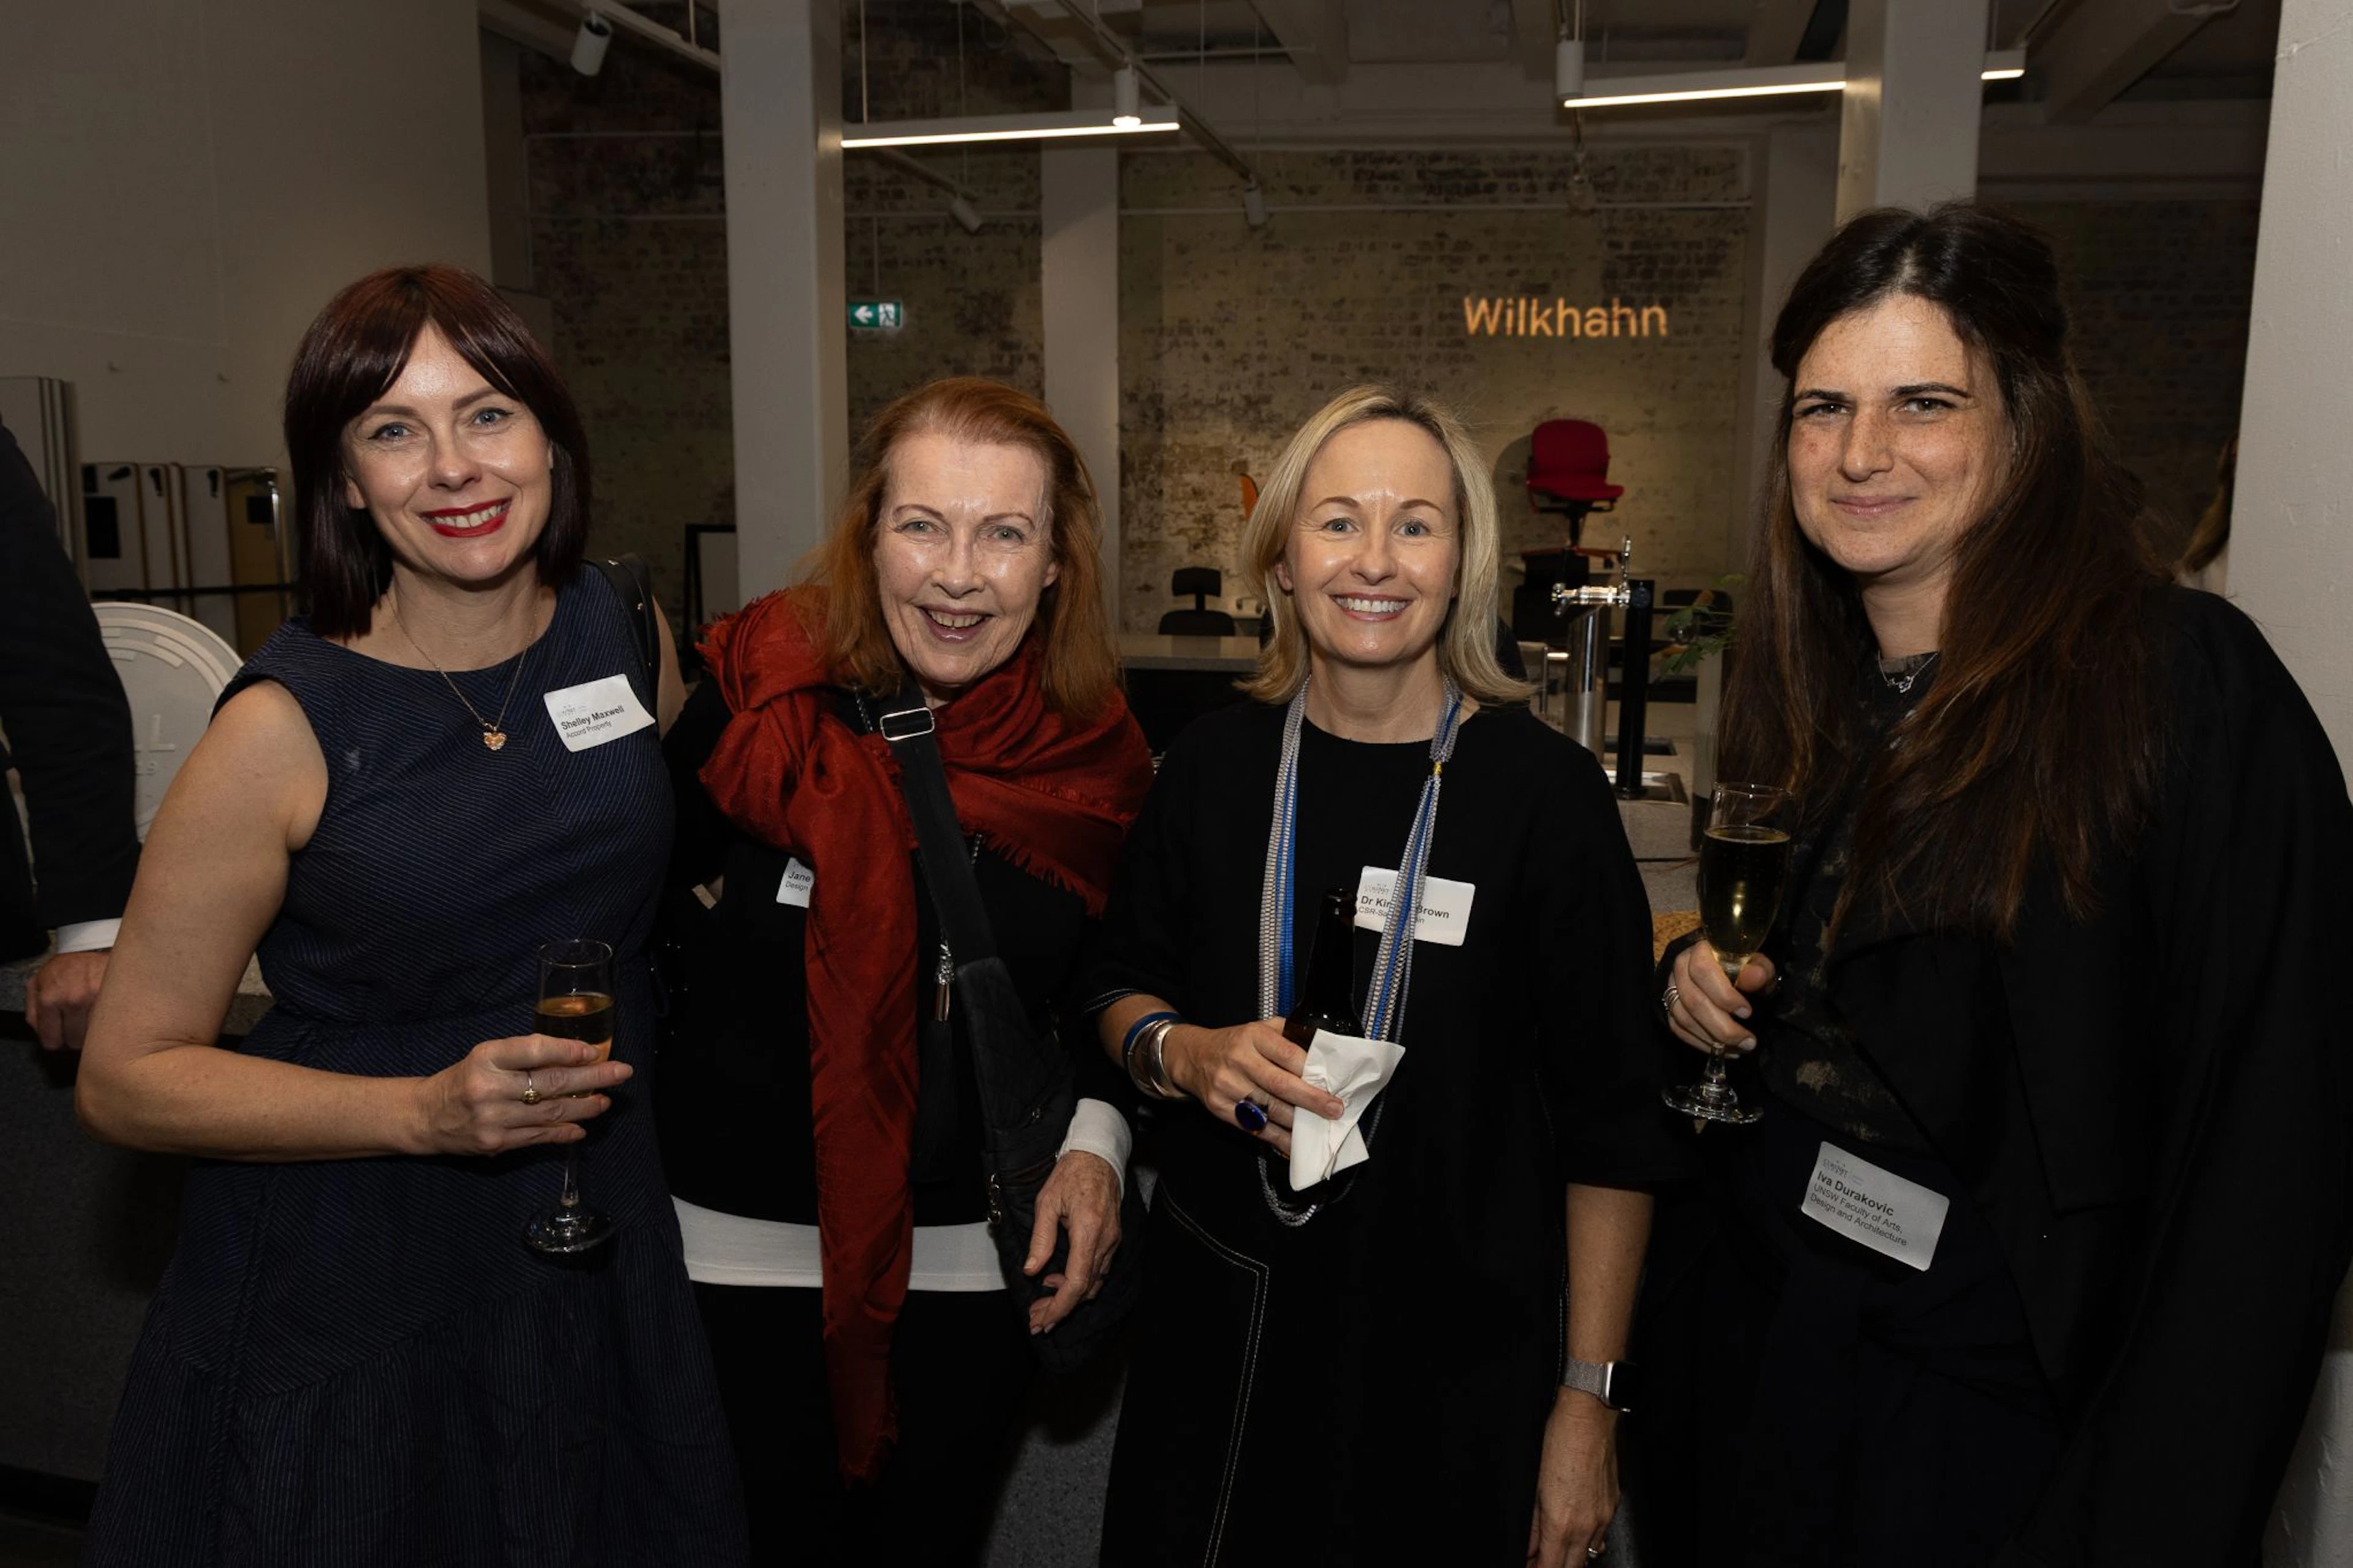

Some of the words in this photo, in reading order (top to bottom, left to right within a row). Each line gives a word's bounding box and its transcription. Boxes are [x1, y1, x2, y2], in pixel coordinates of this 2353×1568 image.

[1463, 297, 1668, 337] Wilkhahn
[560, 716, 591, 730] Shelley
[591, 705, 624, 721] Maxwell
[586, 721, 612, 732] Property
[786, 881, 808, 891] Design
[788, 871, 811, 882] Jane
[1361, 895, 1373, 905] Dr
[1415, 904, 1450, 918] Brown
[1817, 1170, 1832, 1186] Iva
[1835, 1180, 1893, 1216] Durakovic
[1810, 1193, 1836, 1213] Design
[1837, 1210, 1853, 1221] and
[1854, 1217, 1907, 1246] Architecture
[1814, 1183, 1839, 1202] UNSW
[1840, 1197, 1870, 1219] Faculty
[1871, 1214, 1882, 1223] of
[1882, 1219, 1903, 1234] Arts,
